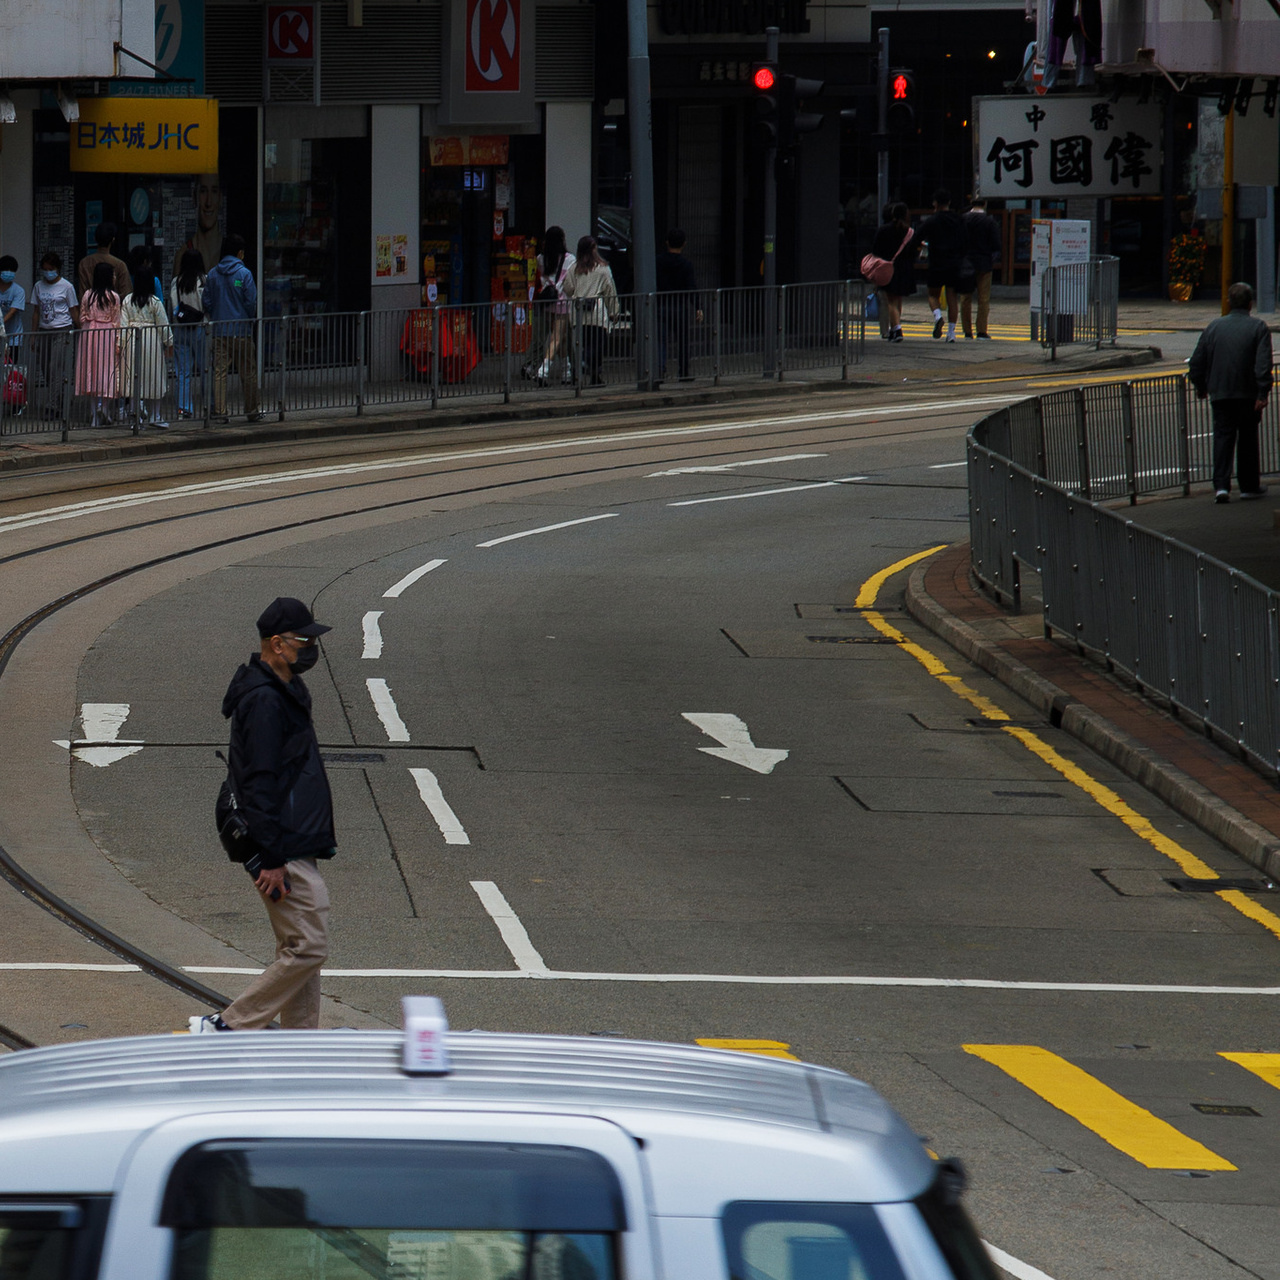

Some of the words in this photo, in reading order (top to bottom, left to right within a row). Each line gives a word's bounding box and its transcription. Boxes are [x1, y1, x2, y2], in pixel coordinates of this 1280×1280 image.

[78, 122, 145, 149] 日本城
[148, 123, 199, 150] JHC
[987, 132, 1153, 188] 何國偉
